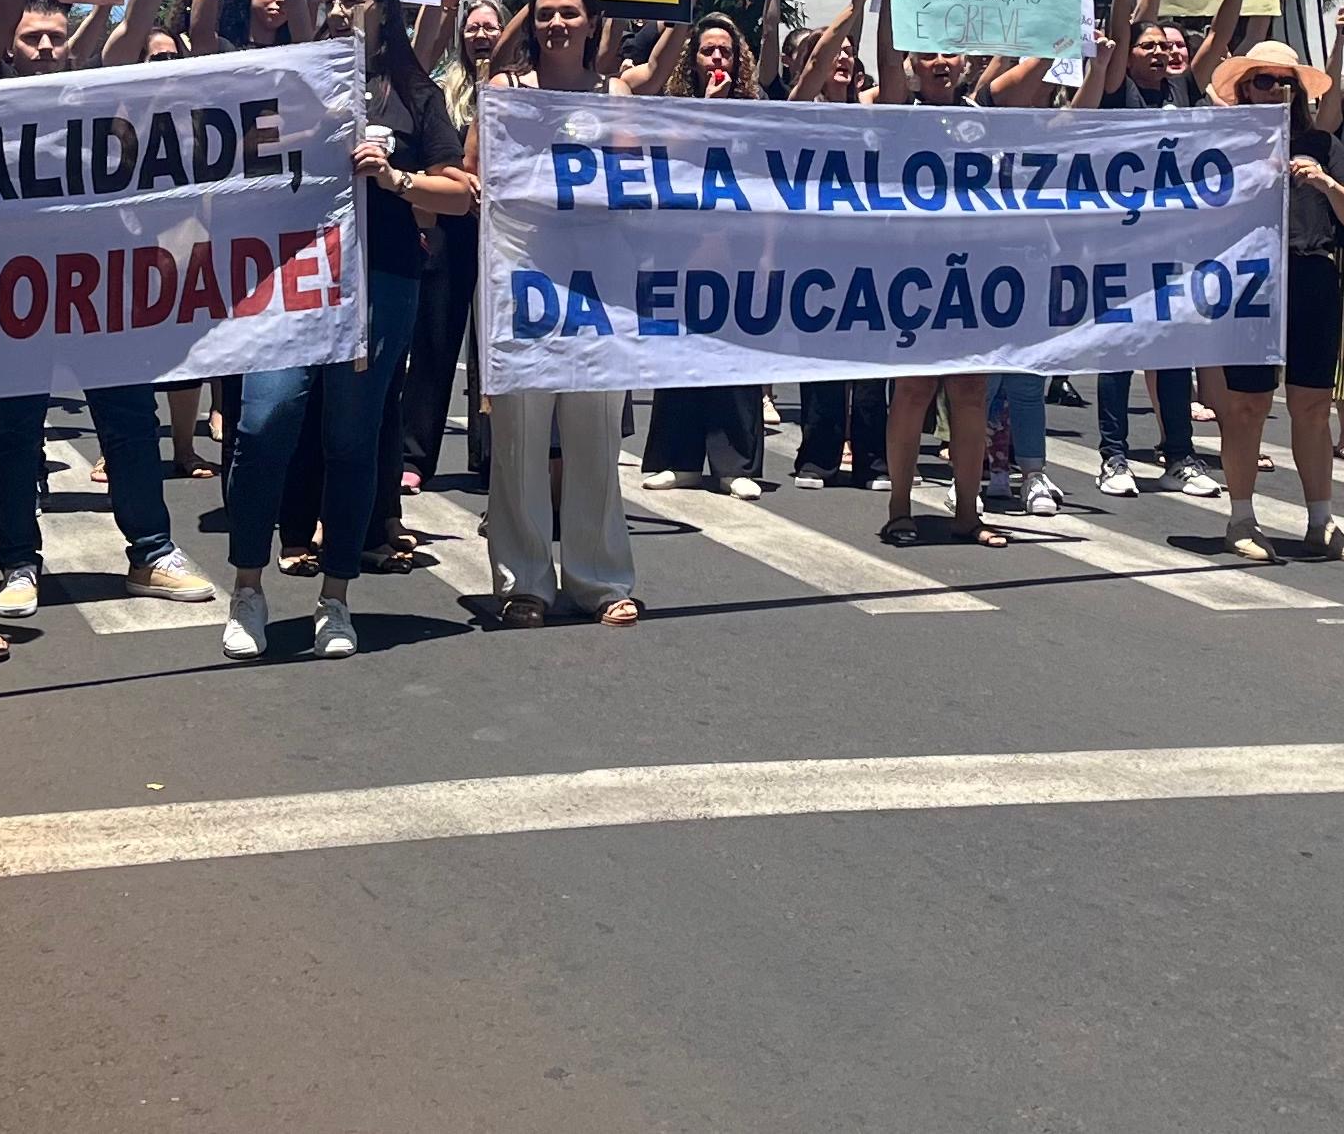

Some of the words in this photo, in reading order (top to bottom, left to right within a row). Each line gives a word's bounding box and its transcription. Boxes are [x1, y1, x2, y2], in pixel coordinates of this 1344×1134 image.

[916, 2, 931, 39] É
[944, 3, 1029, 44] GREVE
[550, 142, 752, 211] PELA
[765, 136, 1236, 226] VALORIZAÇÃO
[510, 268, 614, 340] DA
[635, 252, 1027, 348] EDUCAÇÃO
[1049, 263, 1134, 327] DE
[1151, 257, 1271, 323] FOZ
